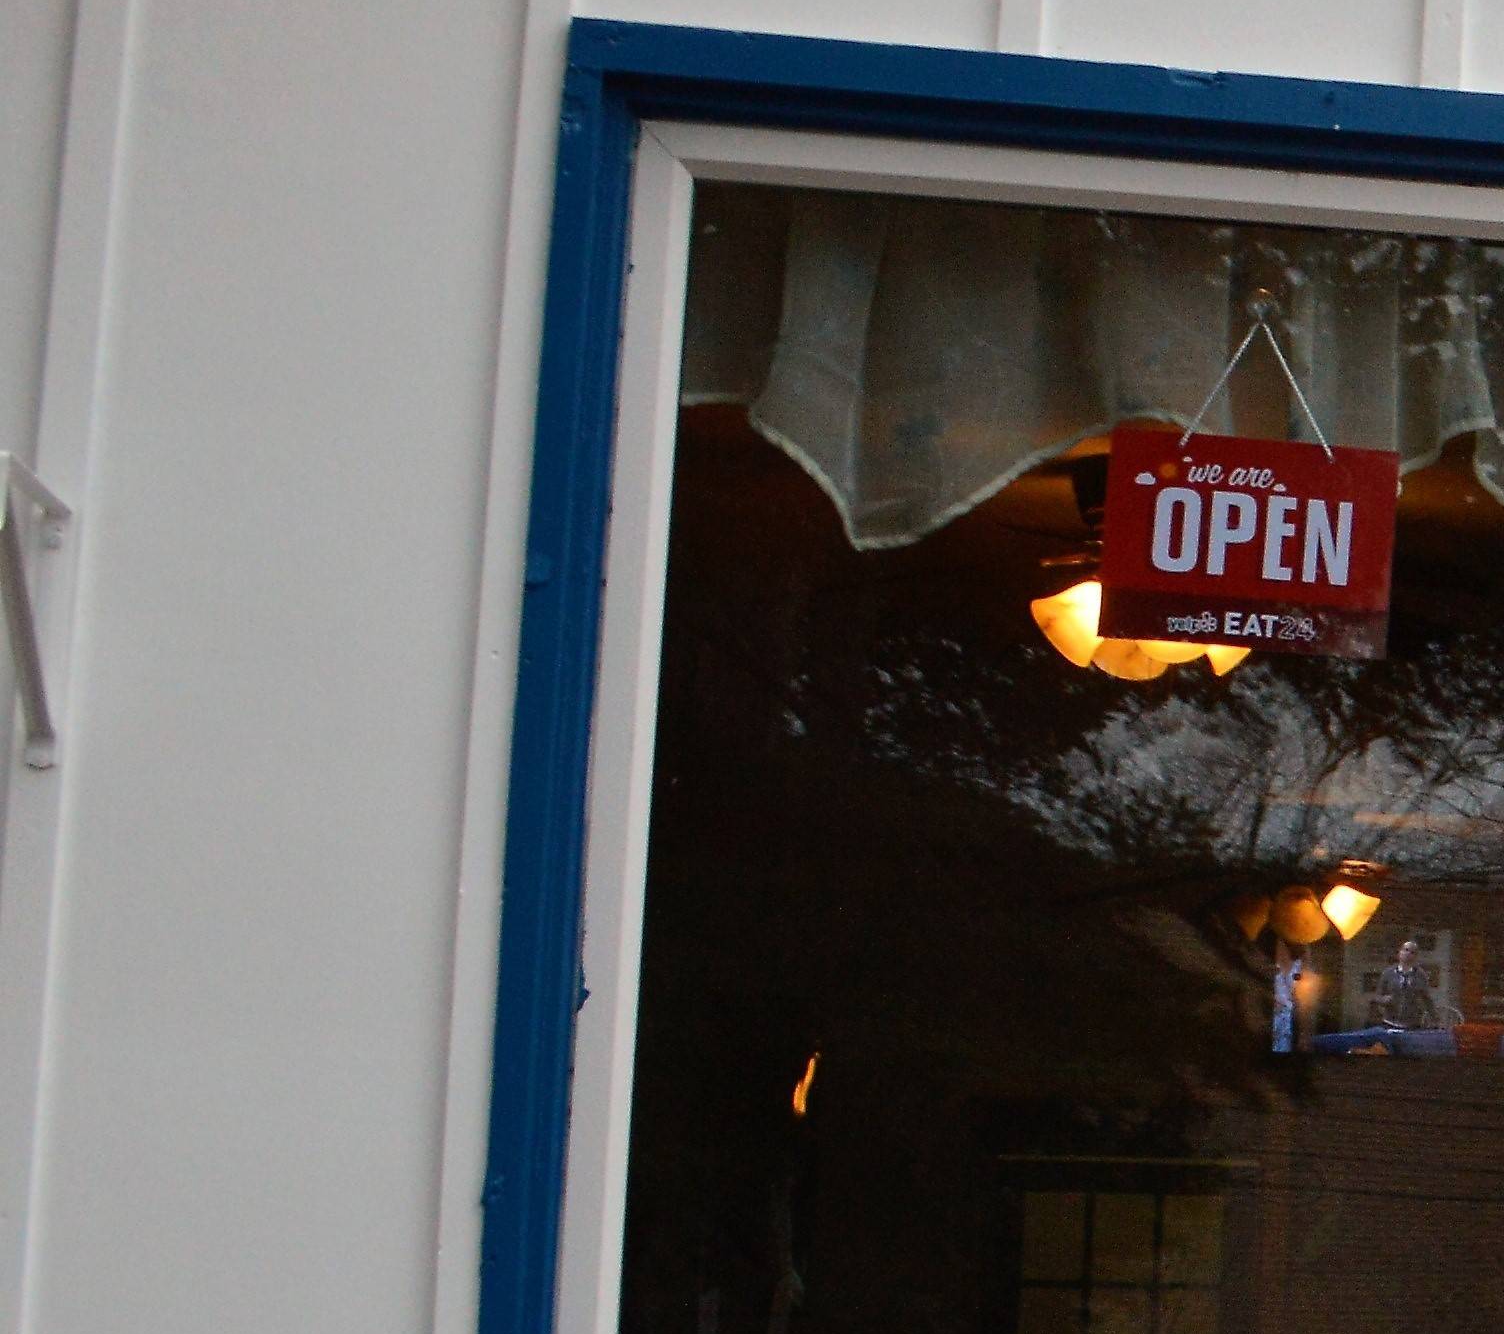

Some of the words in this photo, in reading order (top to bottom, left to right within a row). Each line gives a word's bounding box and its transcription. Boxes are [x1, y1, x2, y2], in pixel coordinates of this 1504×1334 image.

[1188, 464, 1224, 484] we
[1228, 467, 1274, 488] are
[1151, 487, 1354, 587] OPEN
[1223, 611, 1316, 641] EAT24
